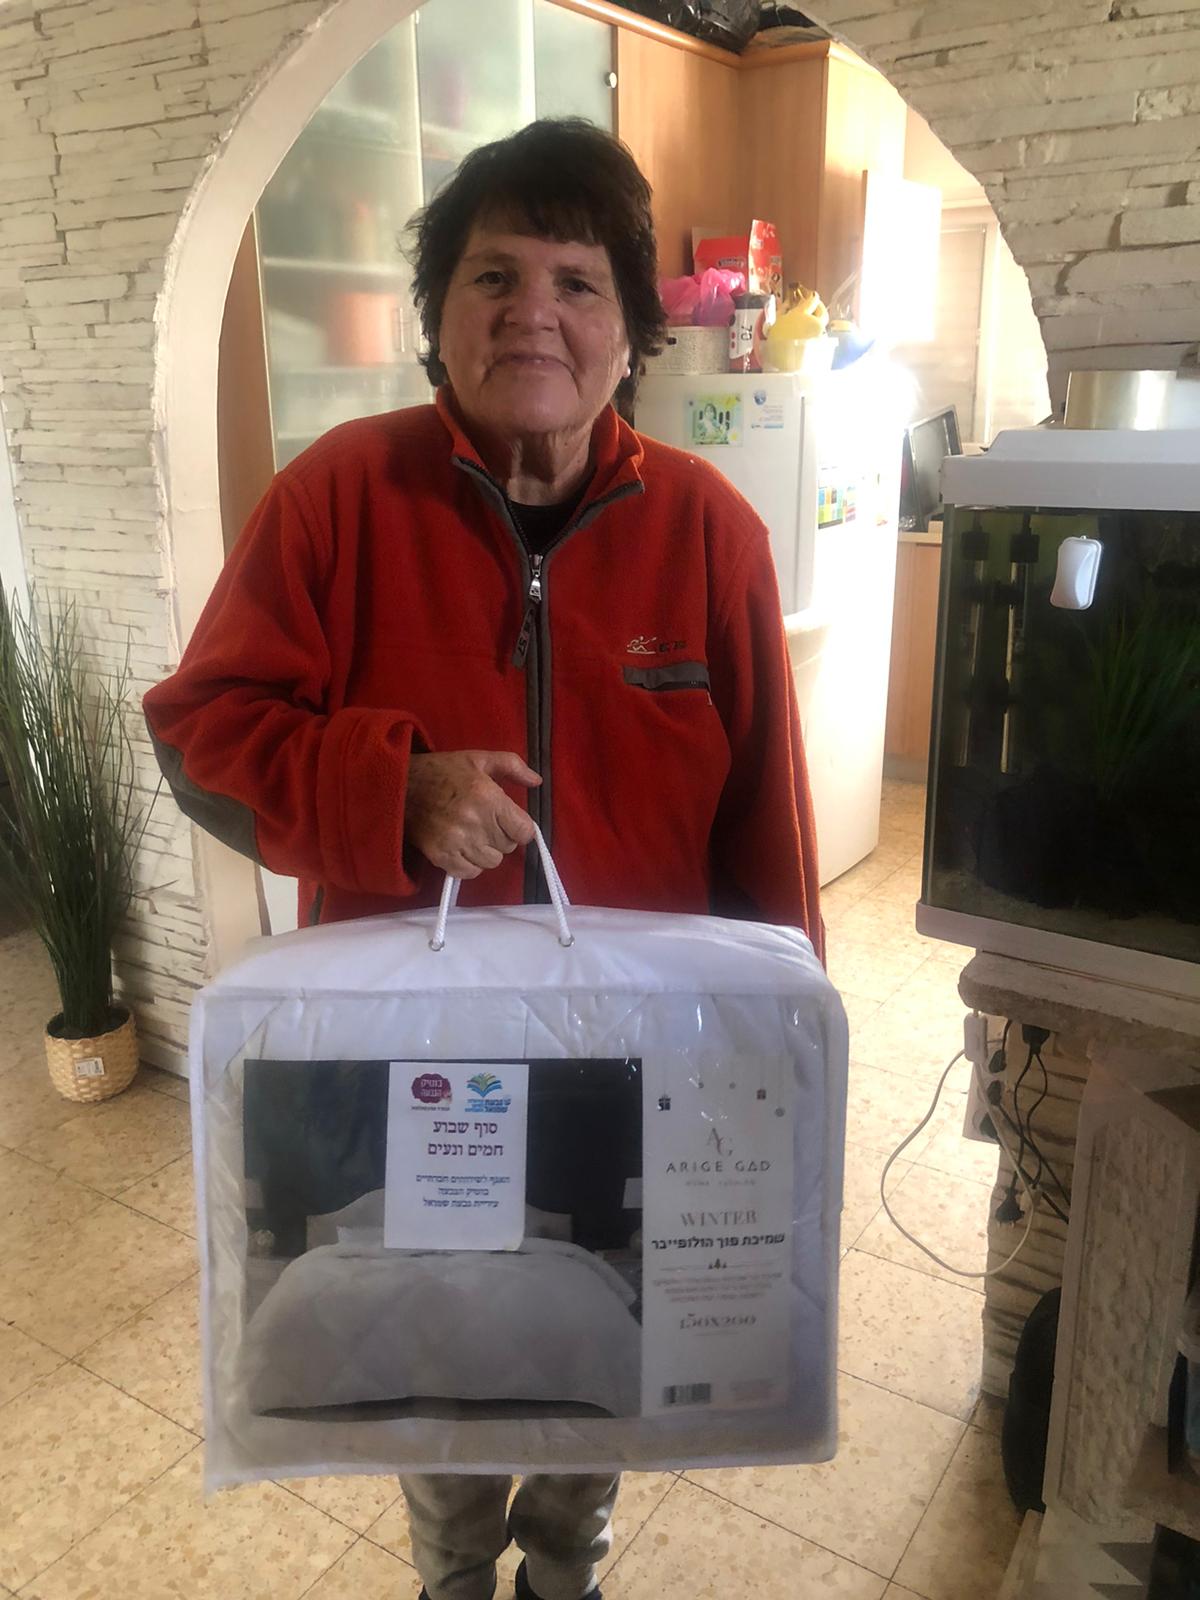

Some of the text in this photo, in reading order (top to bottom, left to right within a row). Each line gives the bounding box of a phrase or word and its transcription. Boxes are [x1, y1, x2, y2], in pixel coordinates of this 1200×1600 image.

[433, 1120, 498, 1138] סוף שבוע
[427, 1142, 504, 1157] חמים ונעים
[666, 1160, 771, 1173] ARIGE GAD
[681, 1210, 758, 1227] WINTER
[651, 1232, 786, 1250] שמיכת פוך הולופייבר
